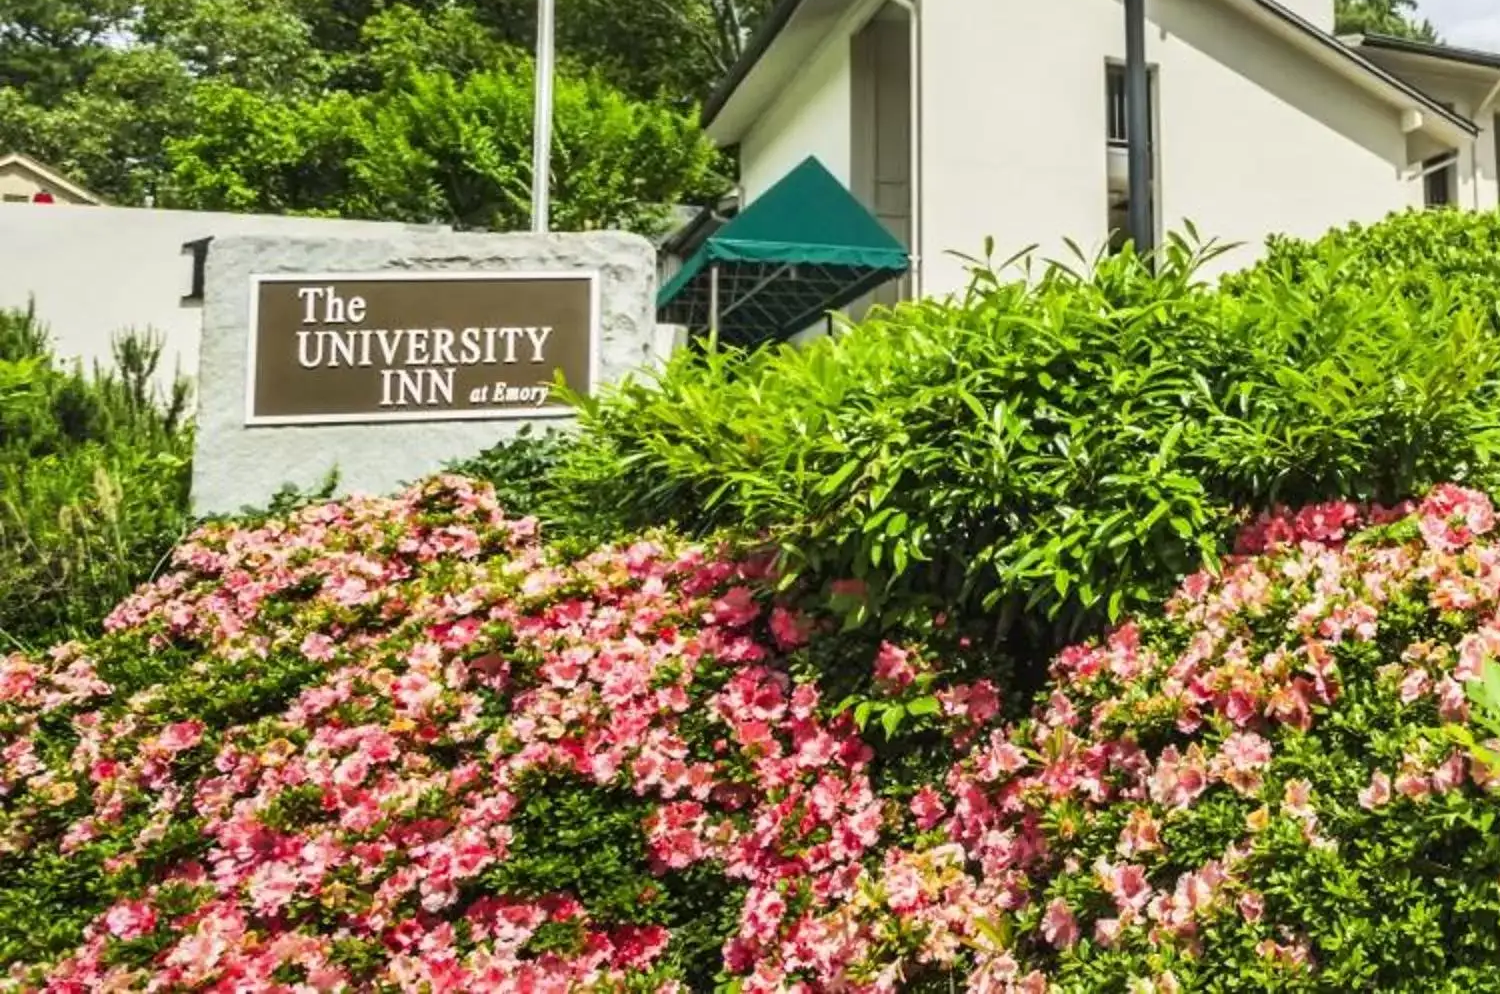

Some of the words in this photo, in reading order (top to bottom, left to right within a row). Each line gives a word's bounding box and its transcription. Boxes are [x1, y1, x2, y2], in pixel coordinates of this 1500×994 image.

[298, 286, 366, 323] The
[296, 327, 552, 368] UNIVERSITY
[379, 369, 456, 405] INN
[469, 387, 489, 402] at
[492, 381, 549, 406] Emory
